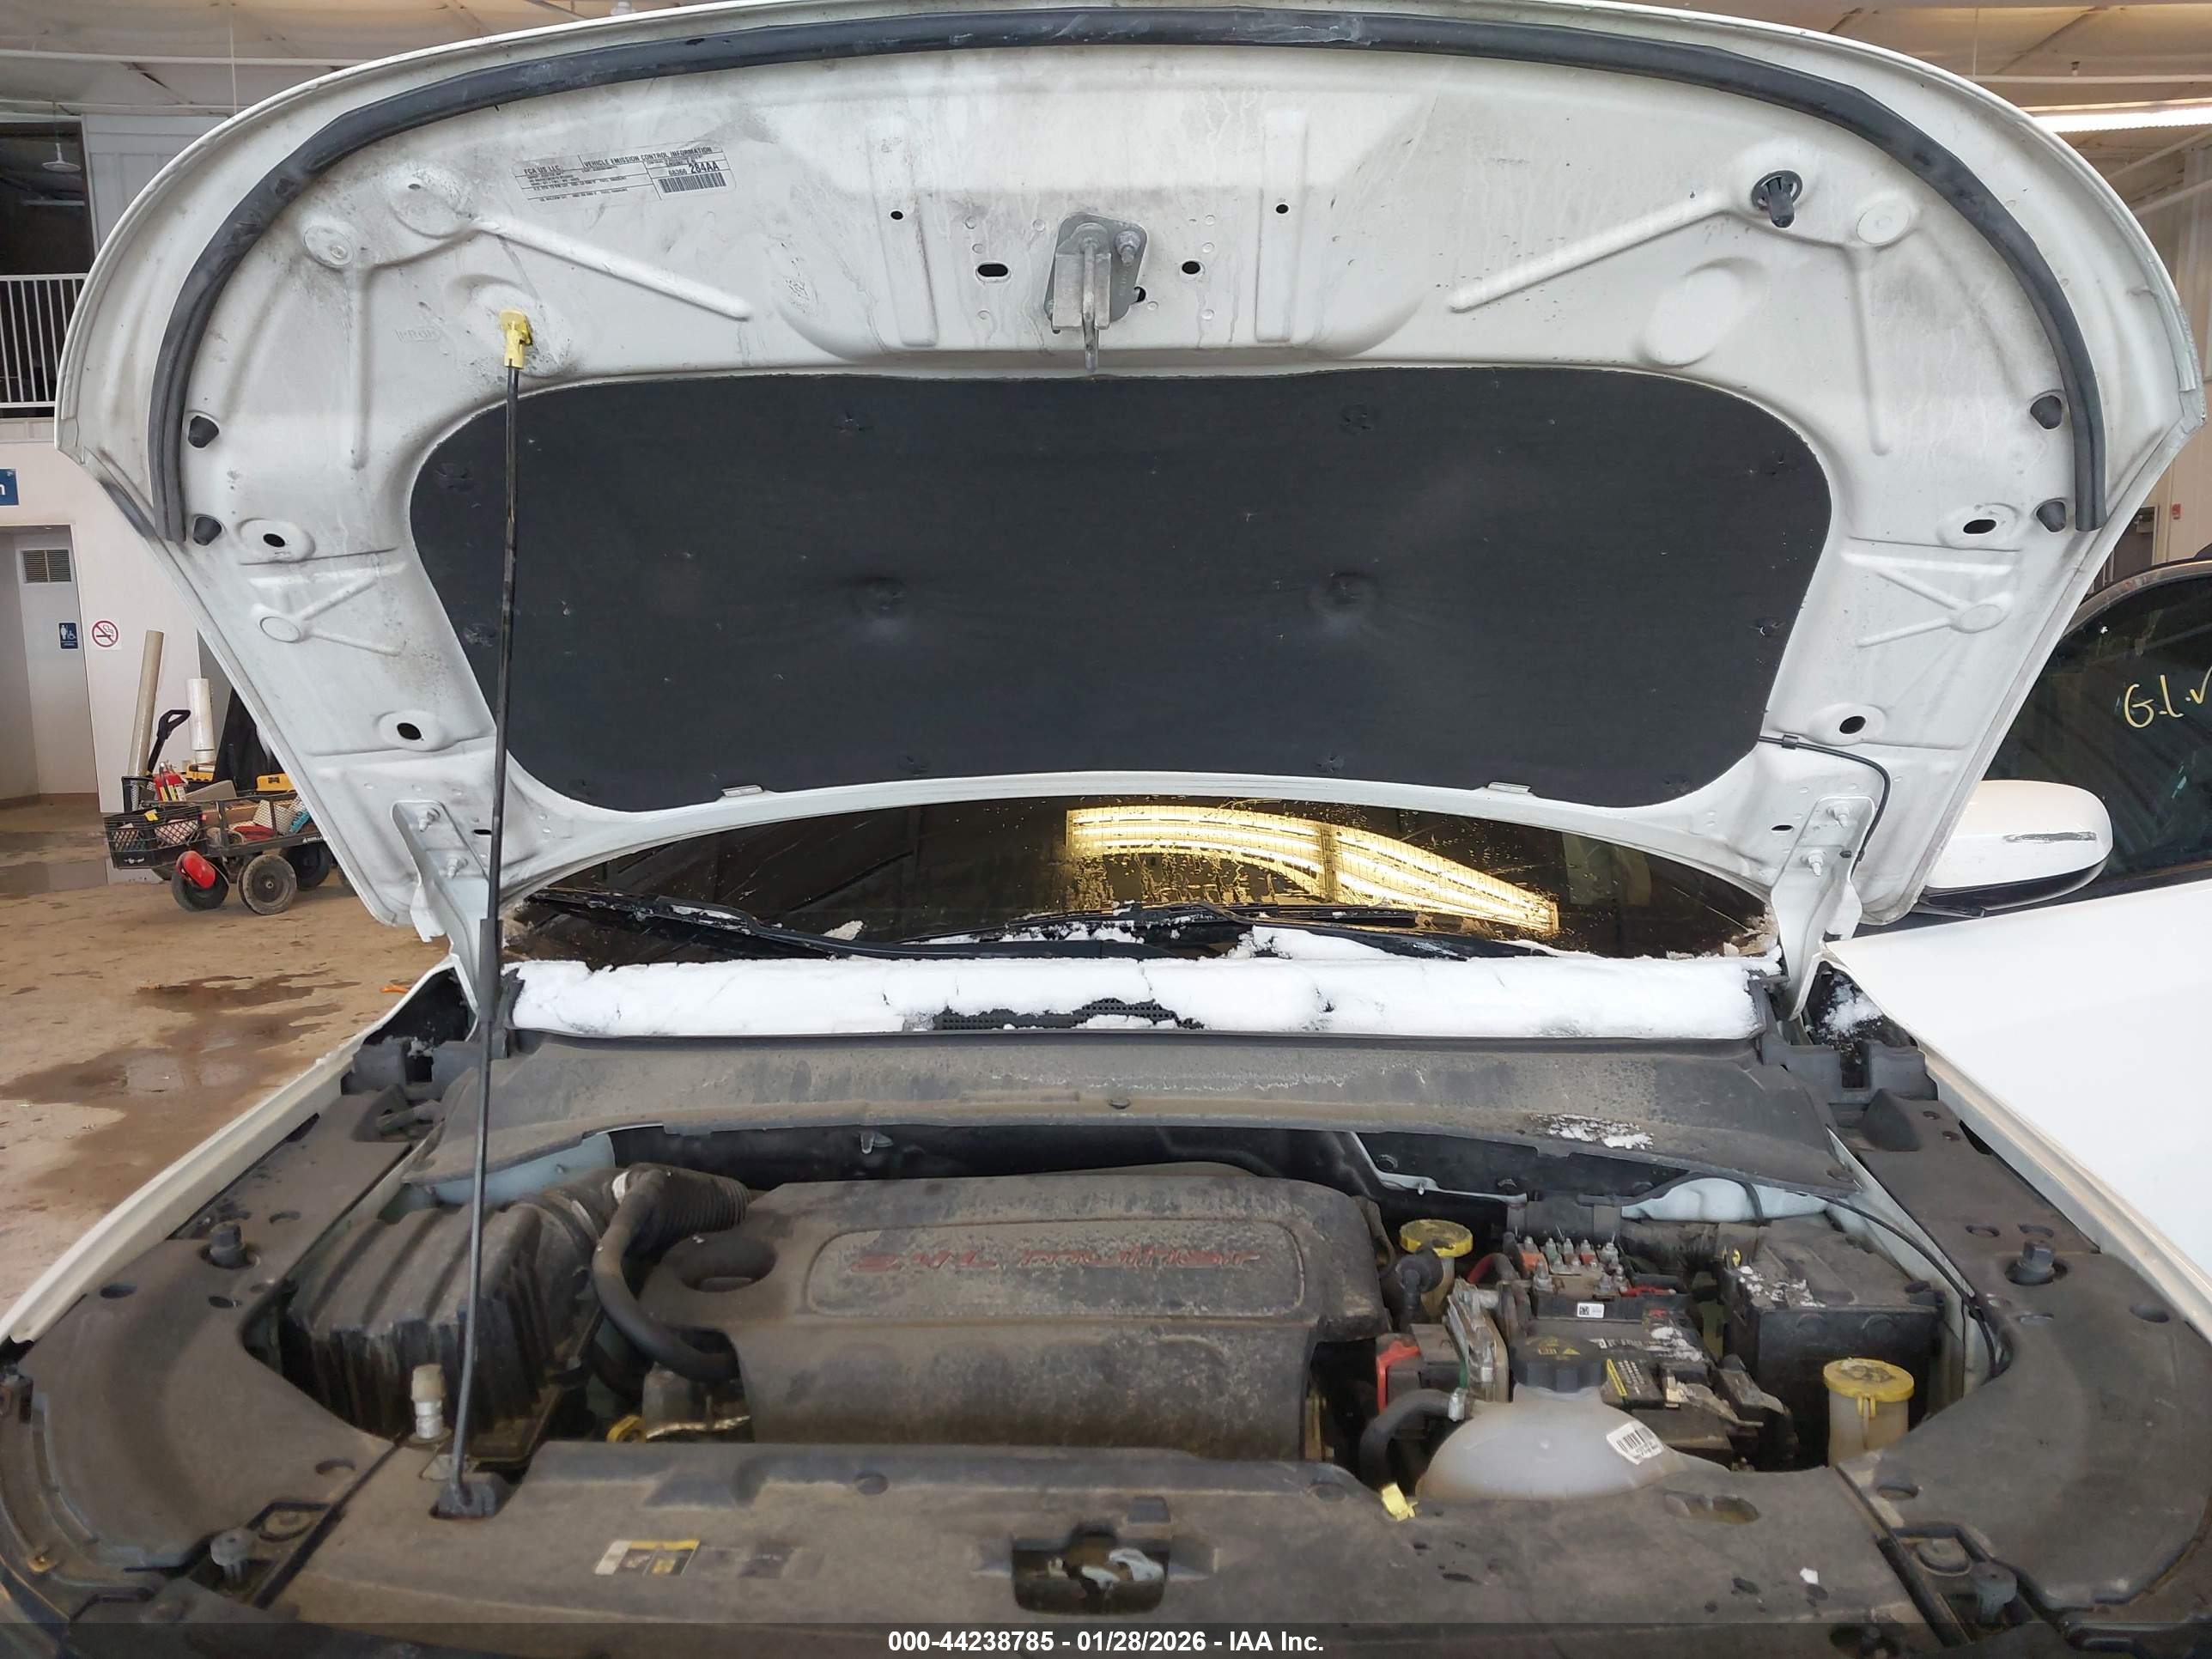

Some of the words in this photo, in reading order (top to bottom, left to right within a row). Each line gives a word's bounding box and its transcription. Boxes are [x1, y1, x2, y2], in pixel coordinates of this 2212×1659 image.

[584, 159, 611, 167] VEHICLE
[611, 155, 640, 166] EMISSION
[640, 152, 669, 161] CONTROL
[670, 146, 712, 158] INFORMATION
[689, 161, 720, 174] 284AA
